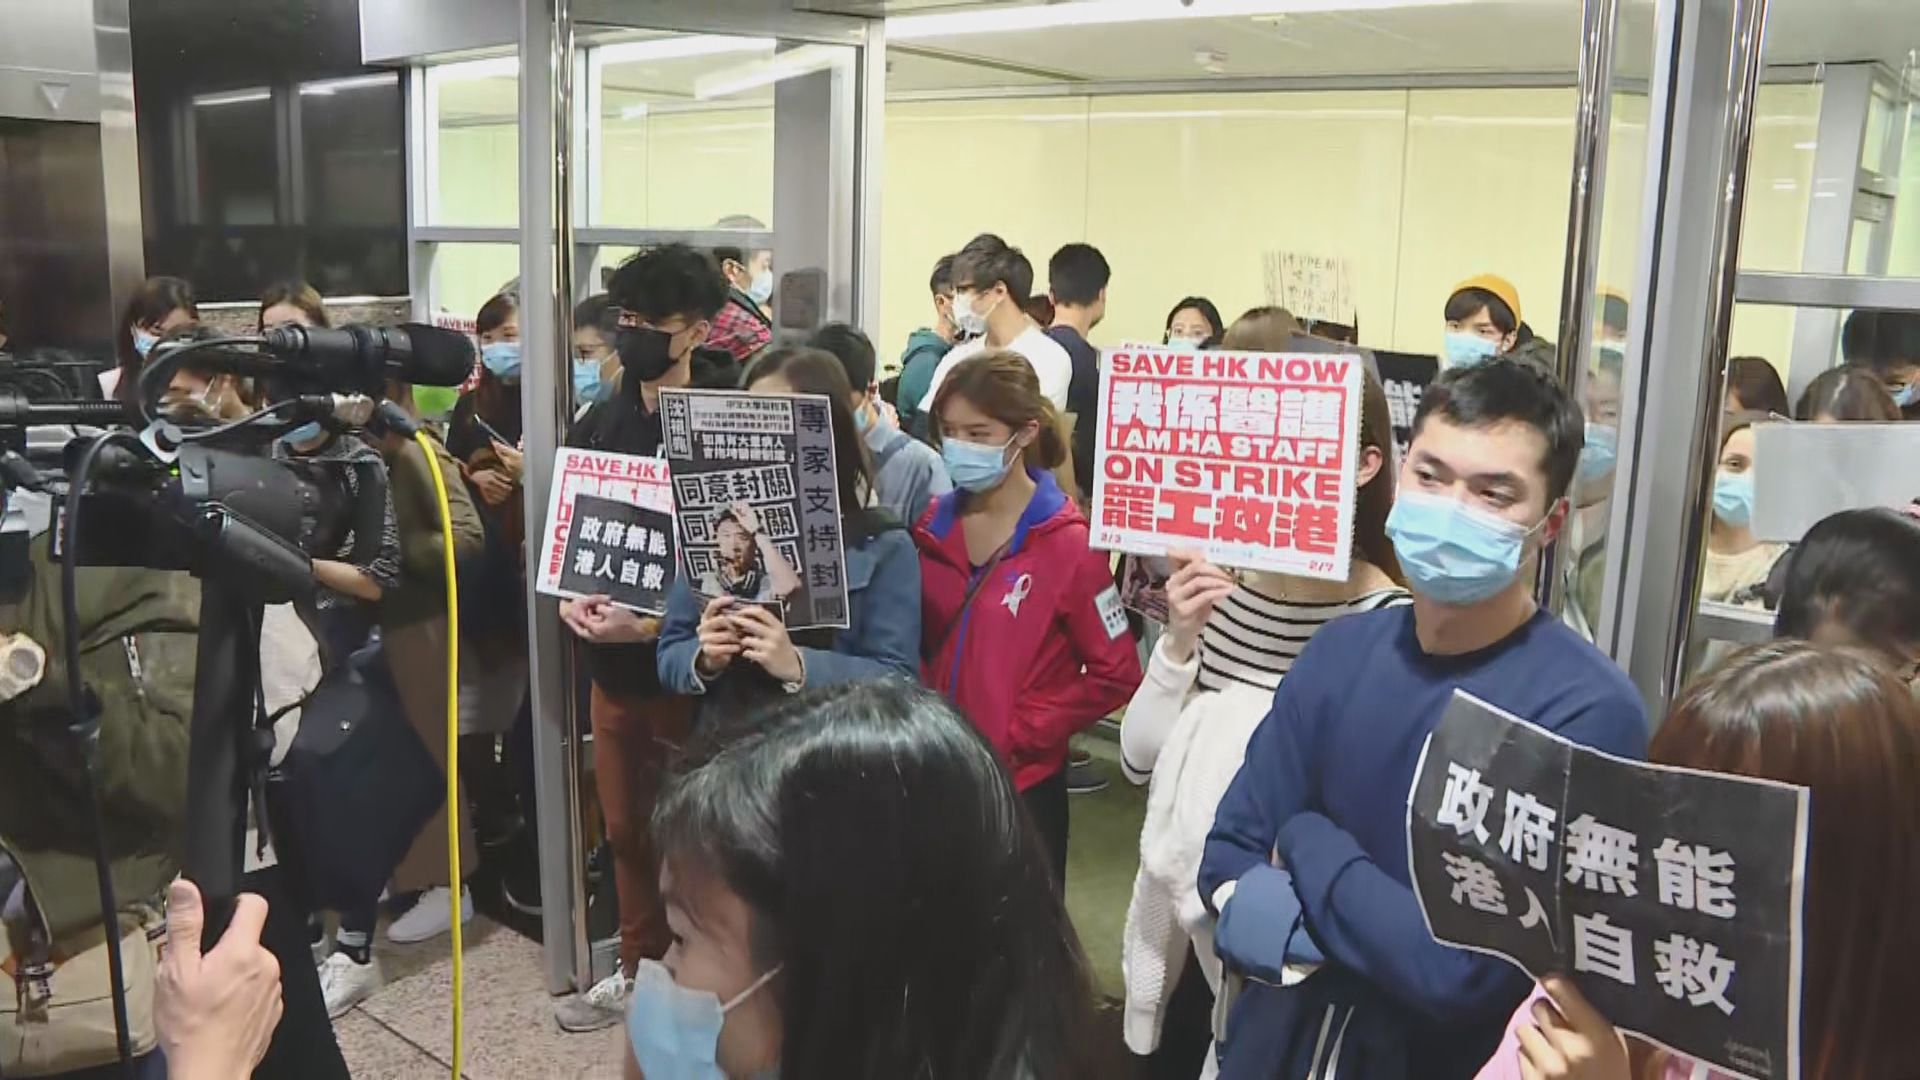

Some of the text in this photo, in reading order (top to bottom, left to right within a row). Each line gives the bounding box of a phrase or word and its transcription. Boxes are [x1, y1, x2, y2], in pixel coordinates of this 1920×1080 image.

[1112, 353, 1349, 383] SAVE HK NOW
[1111, 381, 1342, 440] 我係醫護
[566, 454, 622, 473] SAVE
[627, 462, 656, 479] HK
[1110, 427, 1339, 464] I AM HA STAFF
[677, 468, 792, 503] 同意封關
[1104, 454, 1340, 502] ON STRIKE
[579, 515, 667, 557] 政府無能
[683, 507, 795, 543] 同關
[1102, 482, 1338, 555] 罷工救港
[574, 548, 665, 591] 港人自救
[1436, 761, 1736, 919] 政府無能
[1440, 851, 1736, 1016] 港人自救
